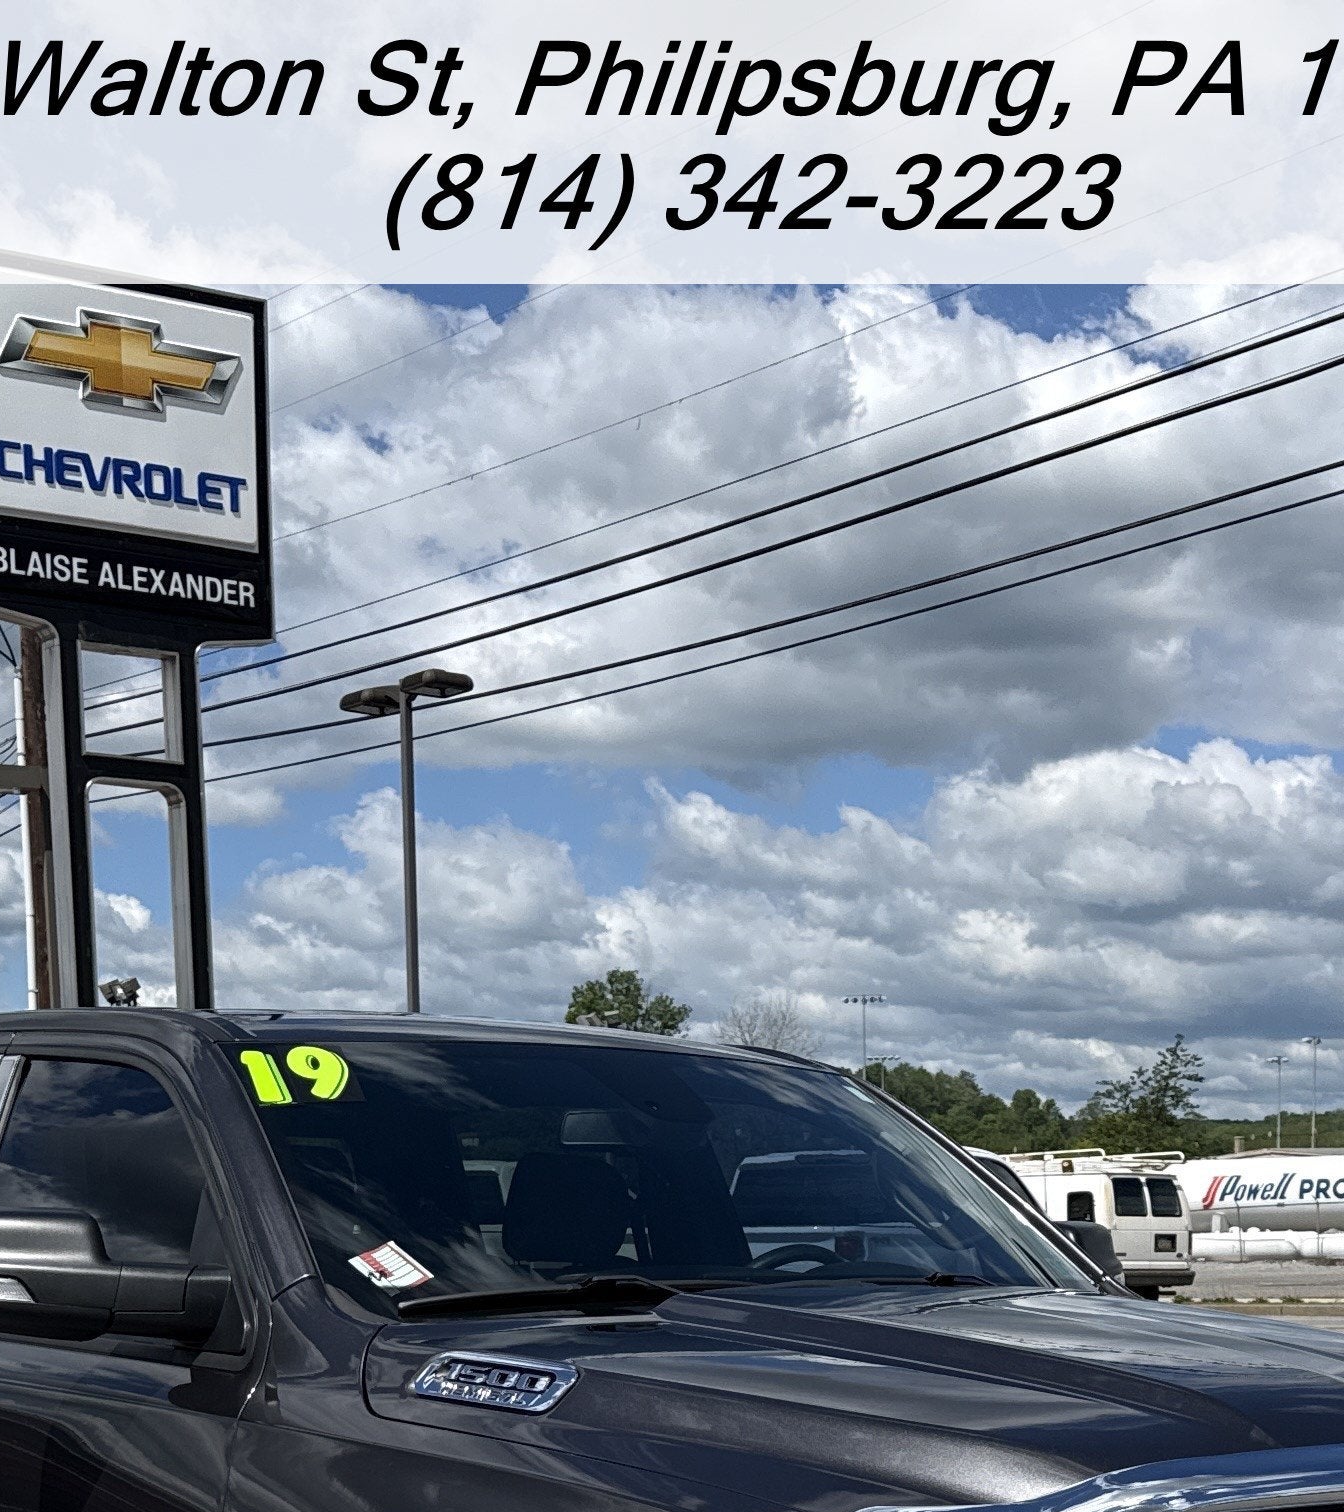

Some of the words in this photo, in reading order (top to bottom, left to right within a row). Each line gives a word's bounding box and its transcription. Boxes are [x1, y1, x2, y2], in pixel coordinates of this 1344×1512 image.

[98, 561, 256, 608] ALEXANDER
[240, 1045, 349, 1105] 19
[448, 1363, 552, 1392] 1500
